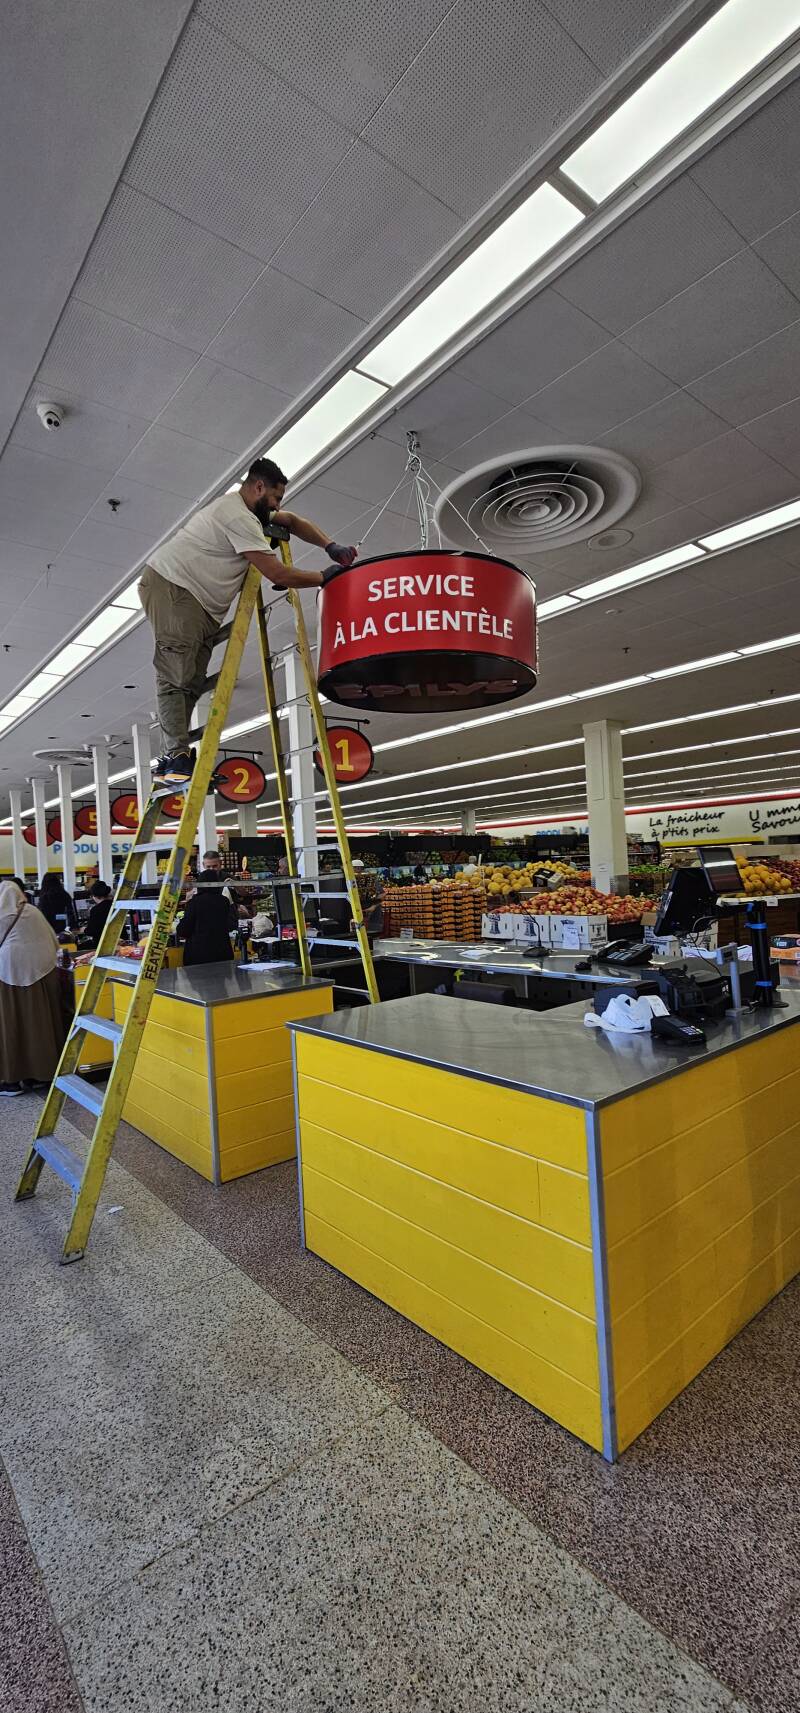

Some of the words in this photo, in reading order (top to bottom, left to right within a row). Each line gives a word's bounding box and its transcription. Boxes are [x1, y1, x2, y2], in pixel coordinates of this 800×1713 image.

[367, 574, 475, 602] SERVICE
[333, 621, 346, 649] À
[350, 617, 378, 642] LA
[384, 607, 514, 640] CLIENTÈLE
[335, 739, 354, 772] 1
[233, 768, 250, 794] 2
[125, 800, 138, 821] 4
[649, 817, 663, 827] La
[651, 828, 660, 838] à
[693, 823, 720, 837] prix
